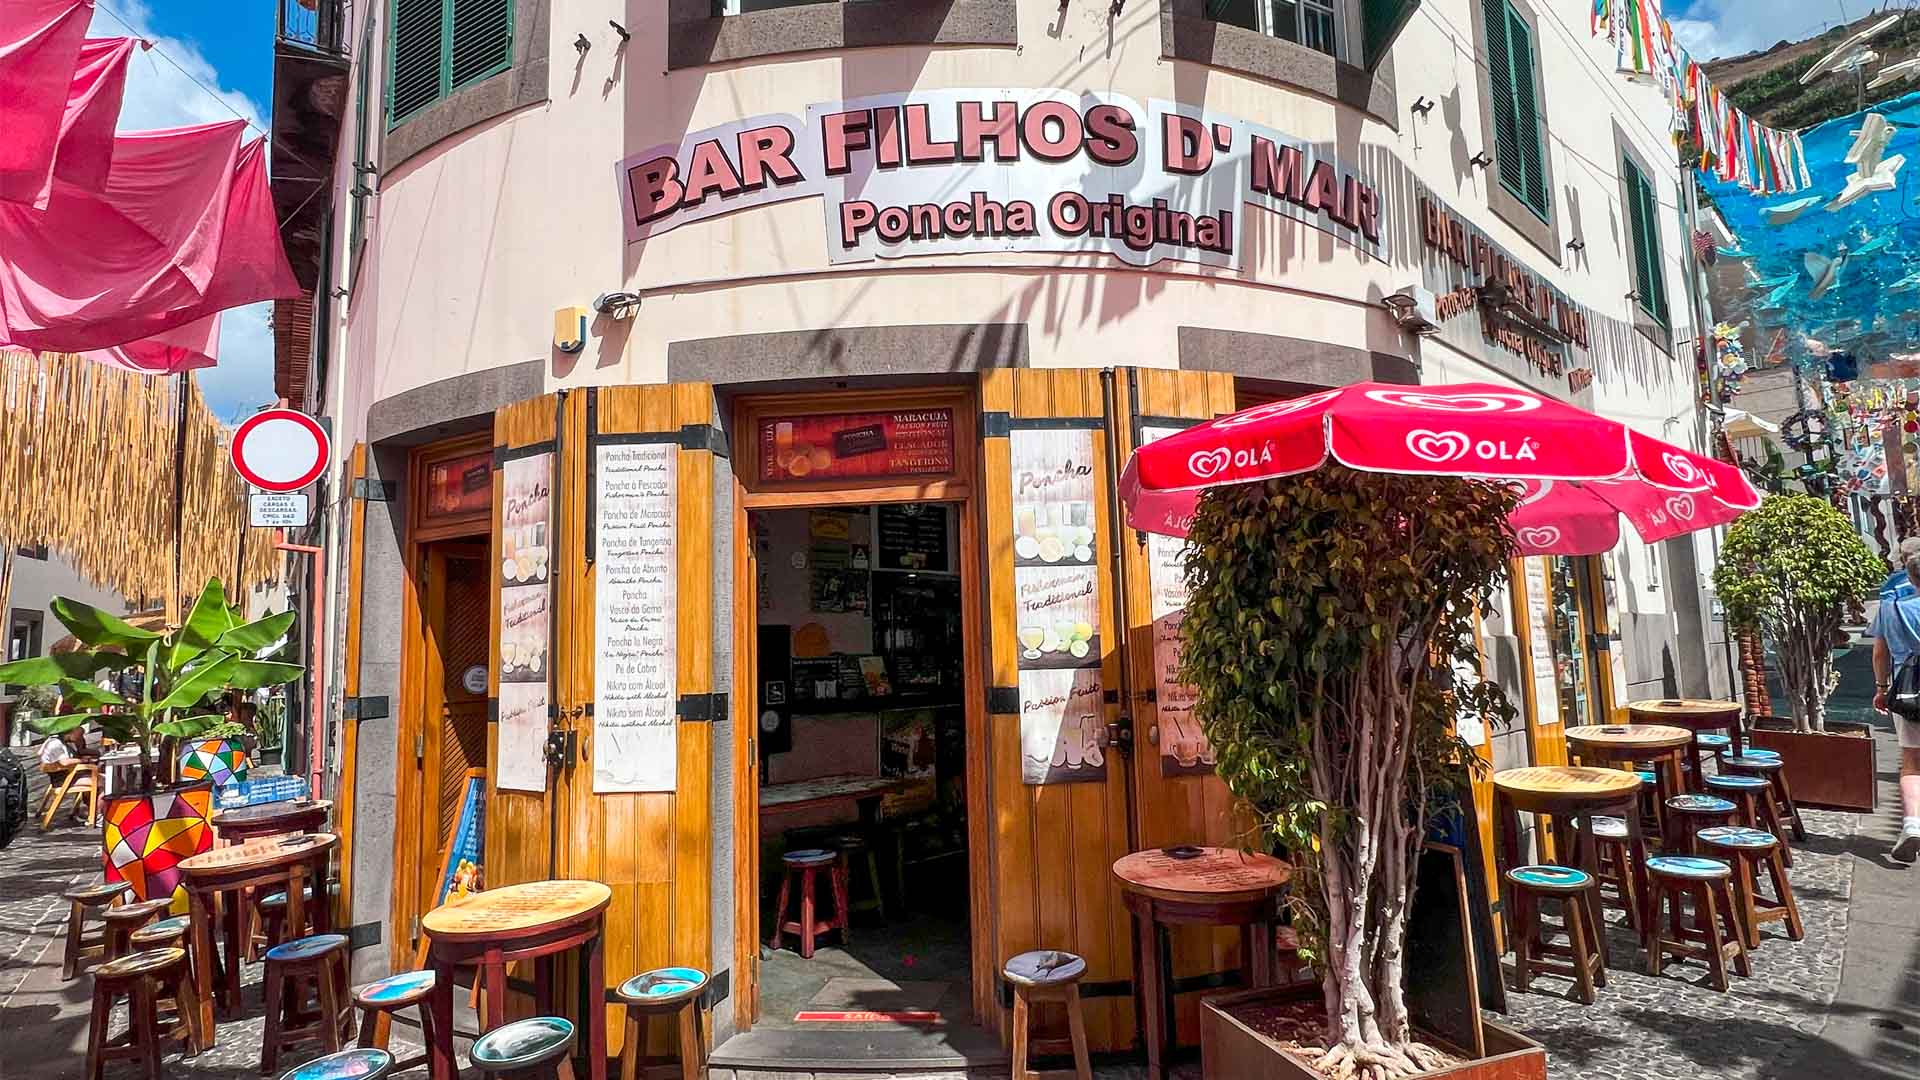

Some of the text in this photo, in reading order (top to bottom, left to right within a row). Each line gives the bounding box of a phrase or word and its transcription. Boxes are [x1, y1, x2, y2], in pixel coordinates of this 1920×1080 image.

[628, 101, 1380, 246] BAR FILHOS D' MAR
[840, 190, 1233, 255] Poncha Original
[1234, 440, 1272, 468] OLÁ
[1475, 436, 1537, 461] OLÁ
[605, 480, 630, 491] Poncha
[1019, 459, 1092, 494] Poncha
[507, 483, 549, 520] Poncha
[622, 590, 648, 600] Poncha
